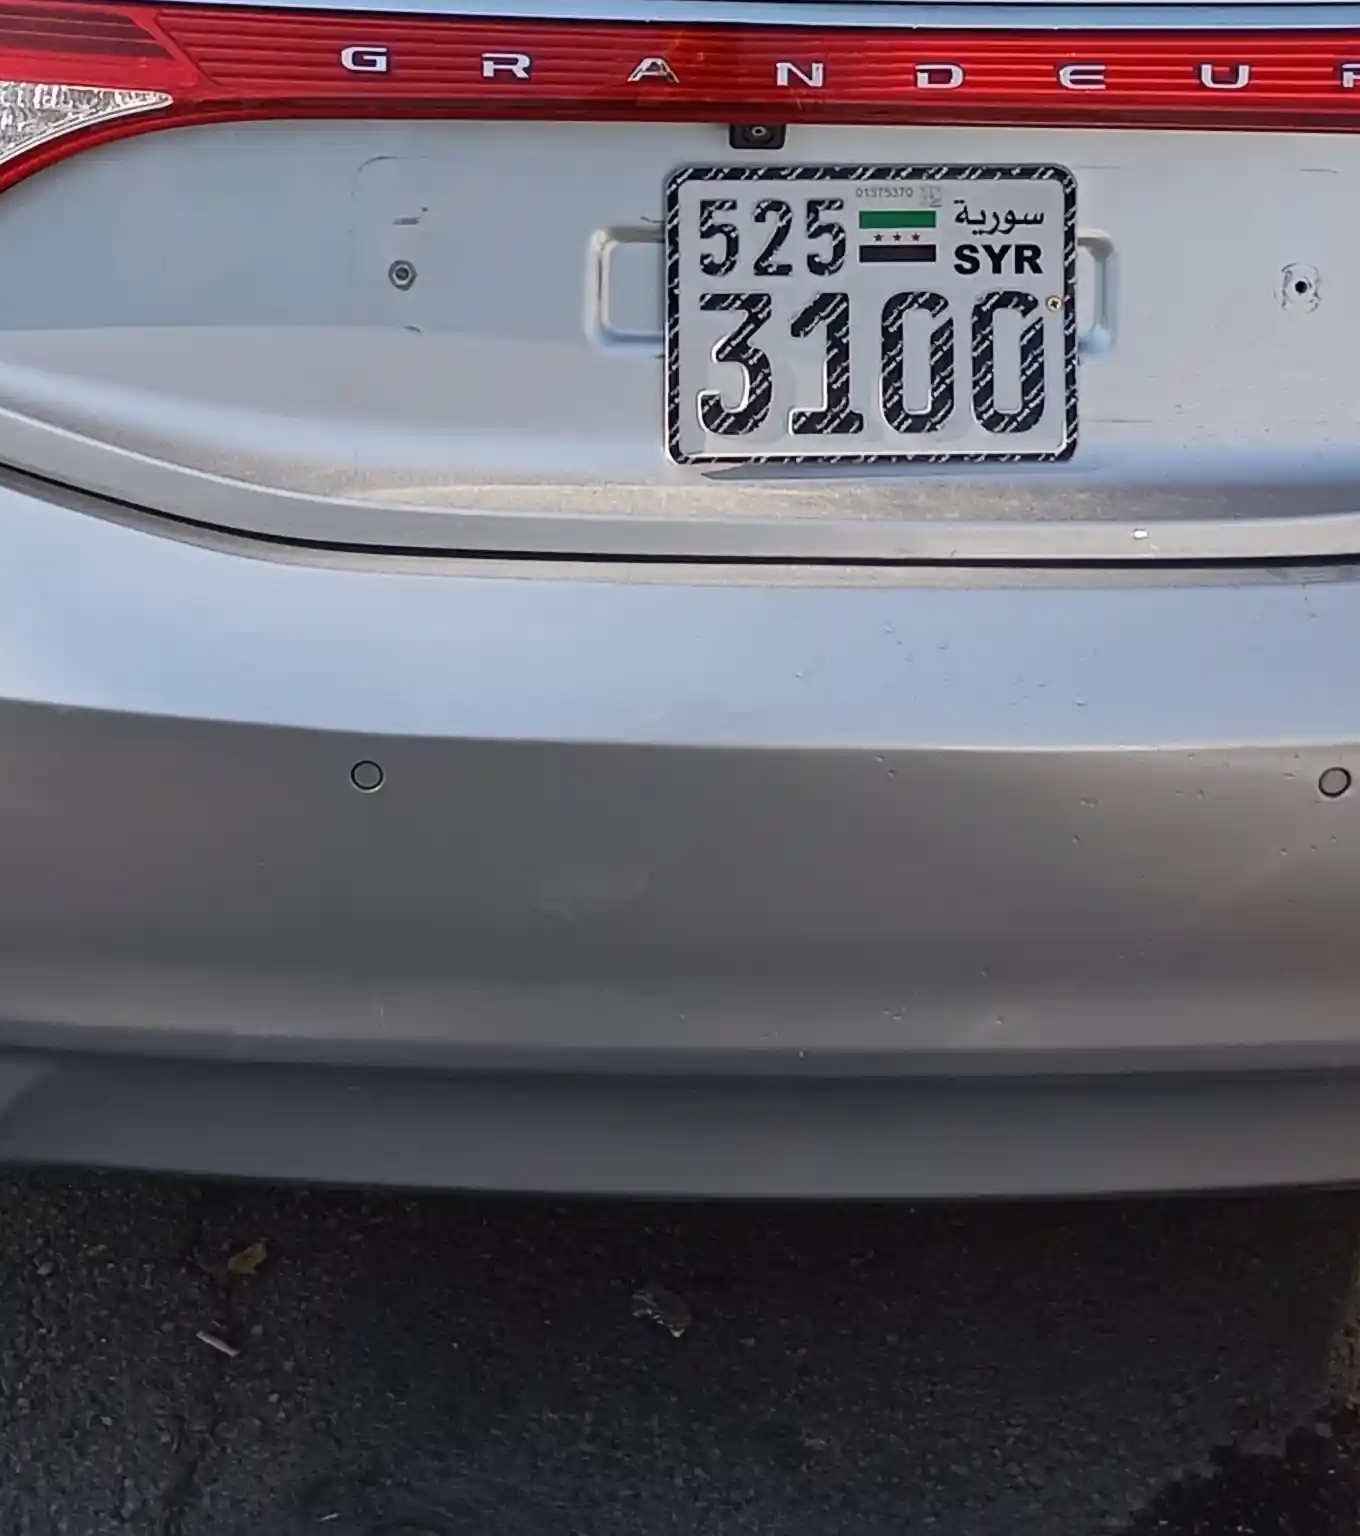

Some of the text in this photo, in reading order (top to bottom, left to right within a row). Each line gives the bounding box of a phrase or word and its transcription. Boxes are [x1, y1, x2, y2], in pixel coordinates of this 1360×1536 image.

[698, 198, 848, 277] 525
[952, 200, 1045, 235] سورية
[952, 244, 1045, 275] SYR
[696, 290, 1047, 435] 3100
